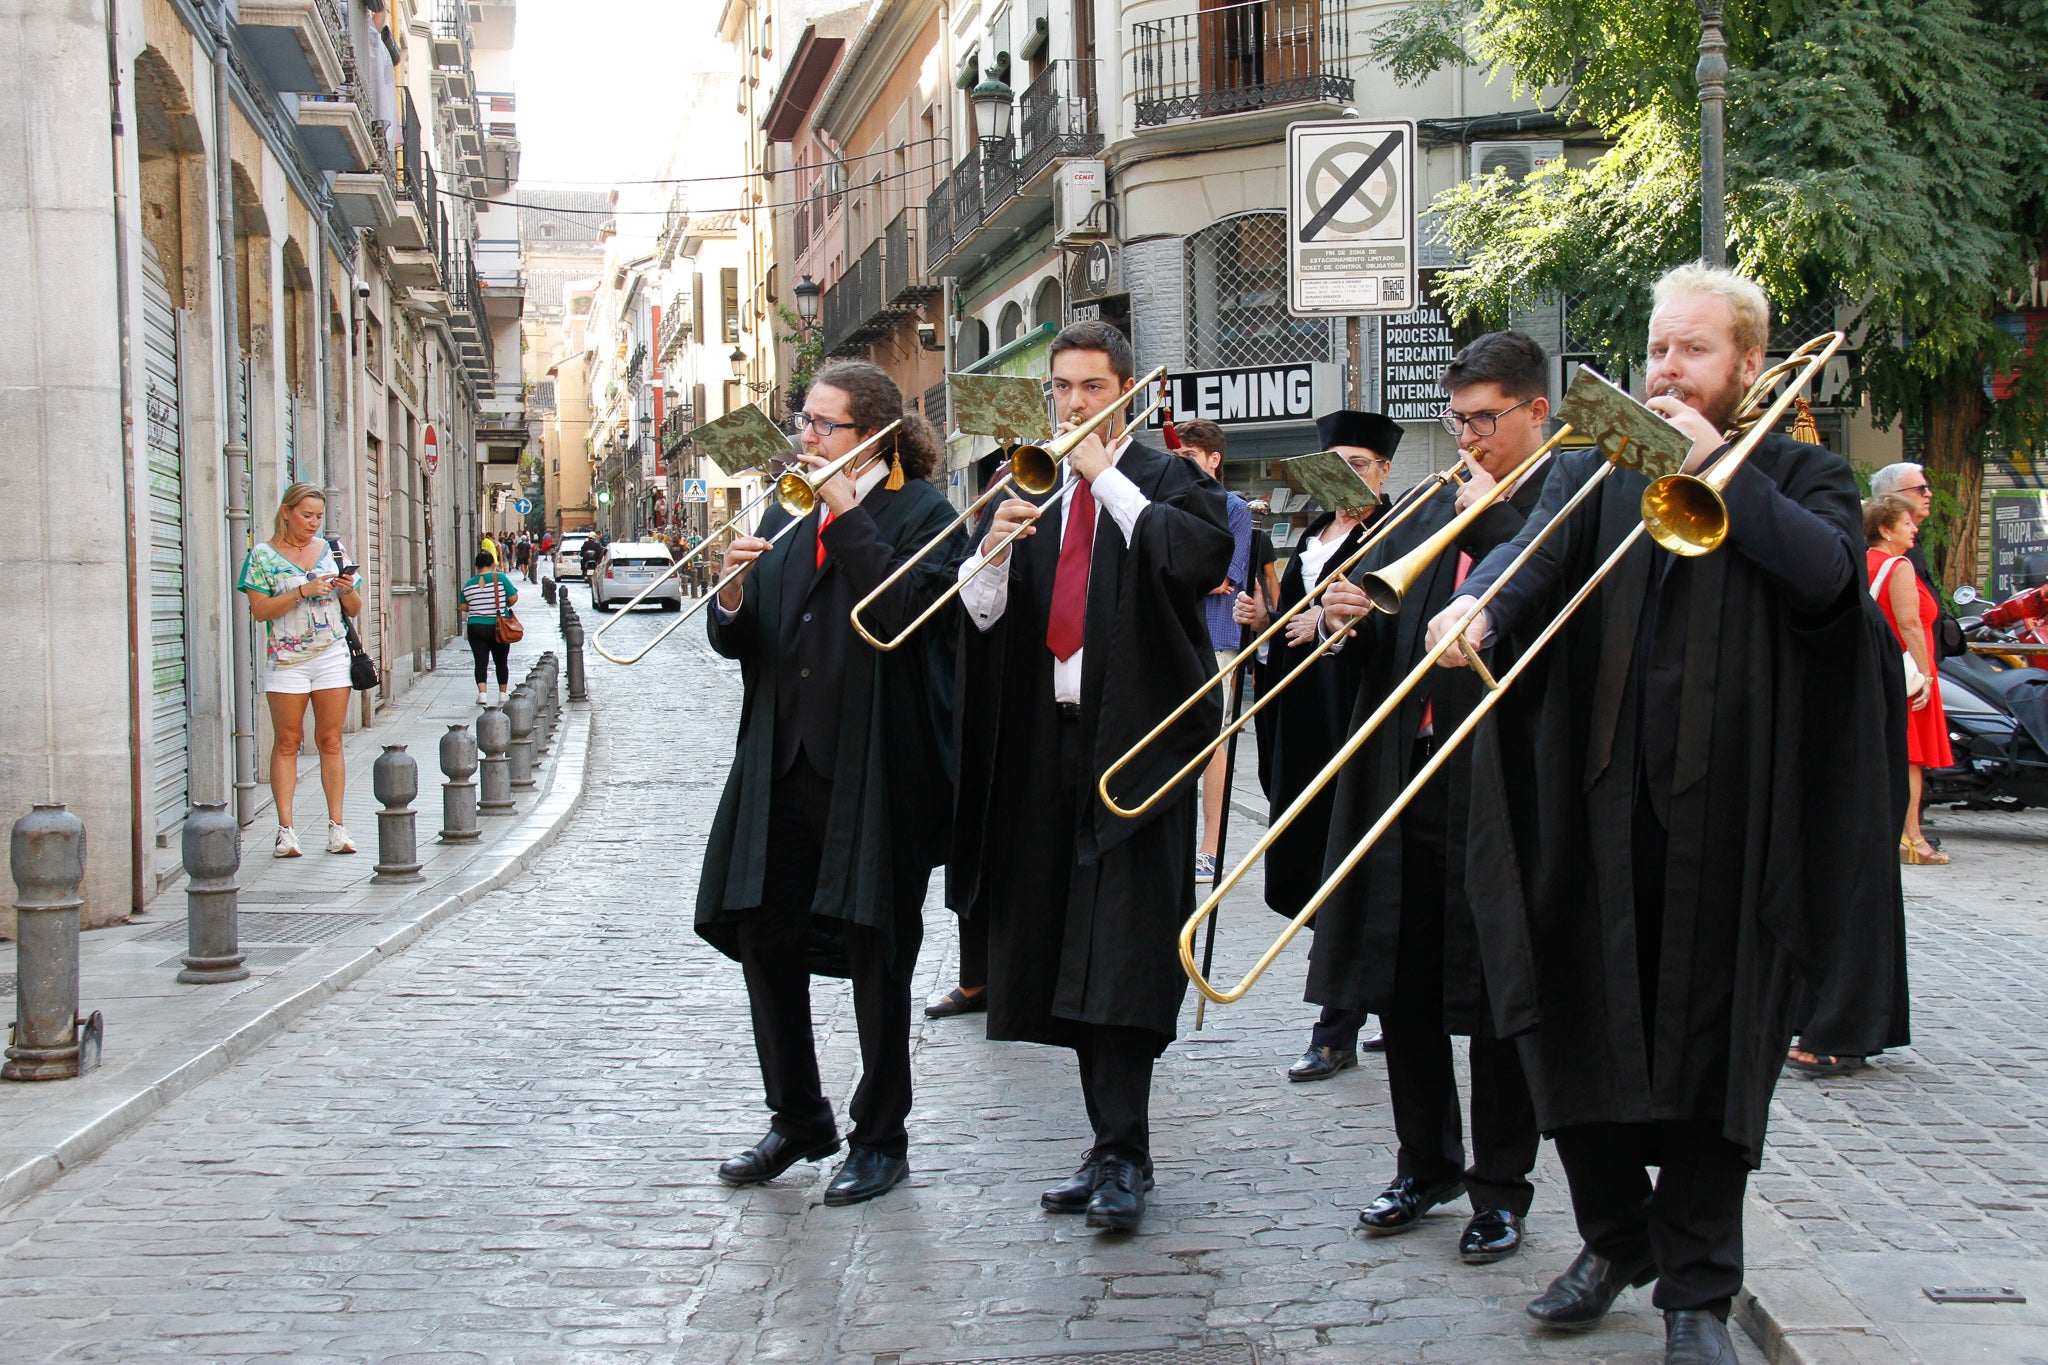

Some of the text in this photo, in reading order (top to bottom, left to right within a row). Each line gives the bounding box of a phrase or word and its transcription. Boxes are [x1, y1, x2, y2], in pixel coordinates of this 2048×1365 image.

[1387, 309, 1445, 325] LABORAL
[1387, 327, 1454, 344] PROCESAL
[1387, 346, 1456, 362] MERCANTIL
[1150, 370, 1310, 424] FLEMING
[1386, 383, 1449, 400] INTERNAC
[1999, 523, 2008, 539] TU
[2008, 522, 2031, 543] ROPA
[1998, 574, 2009, 591] DE
